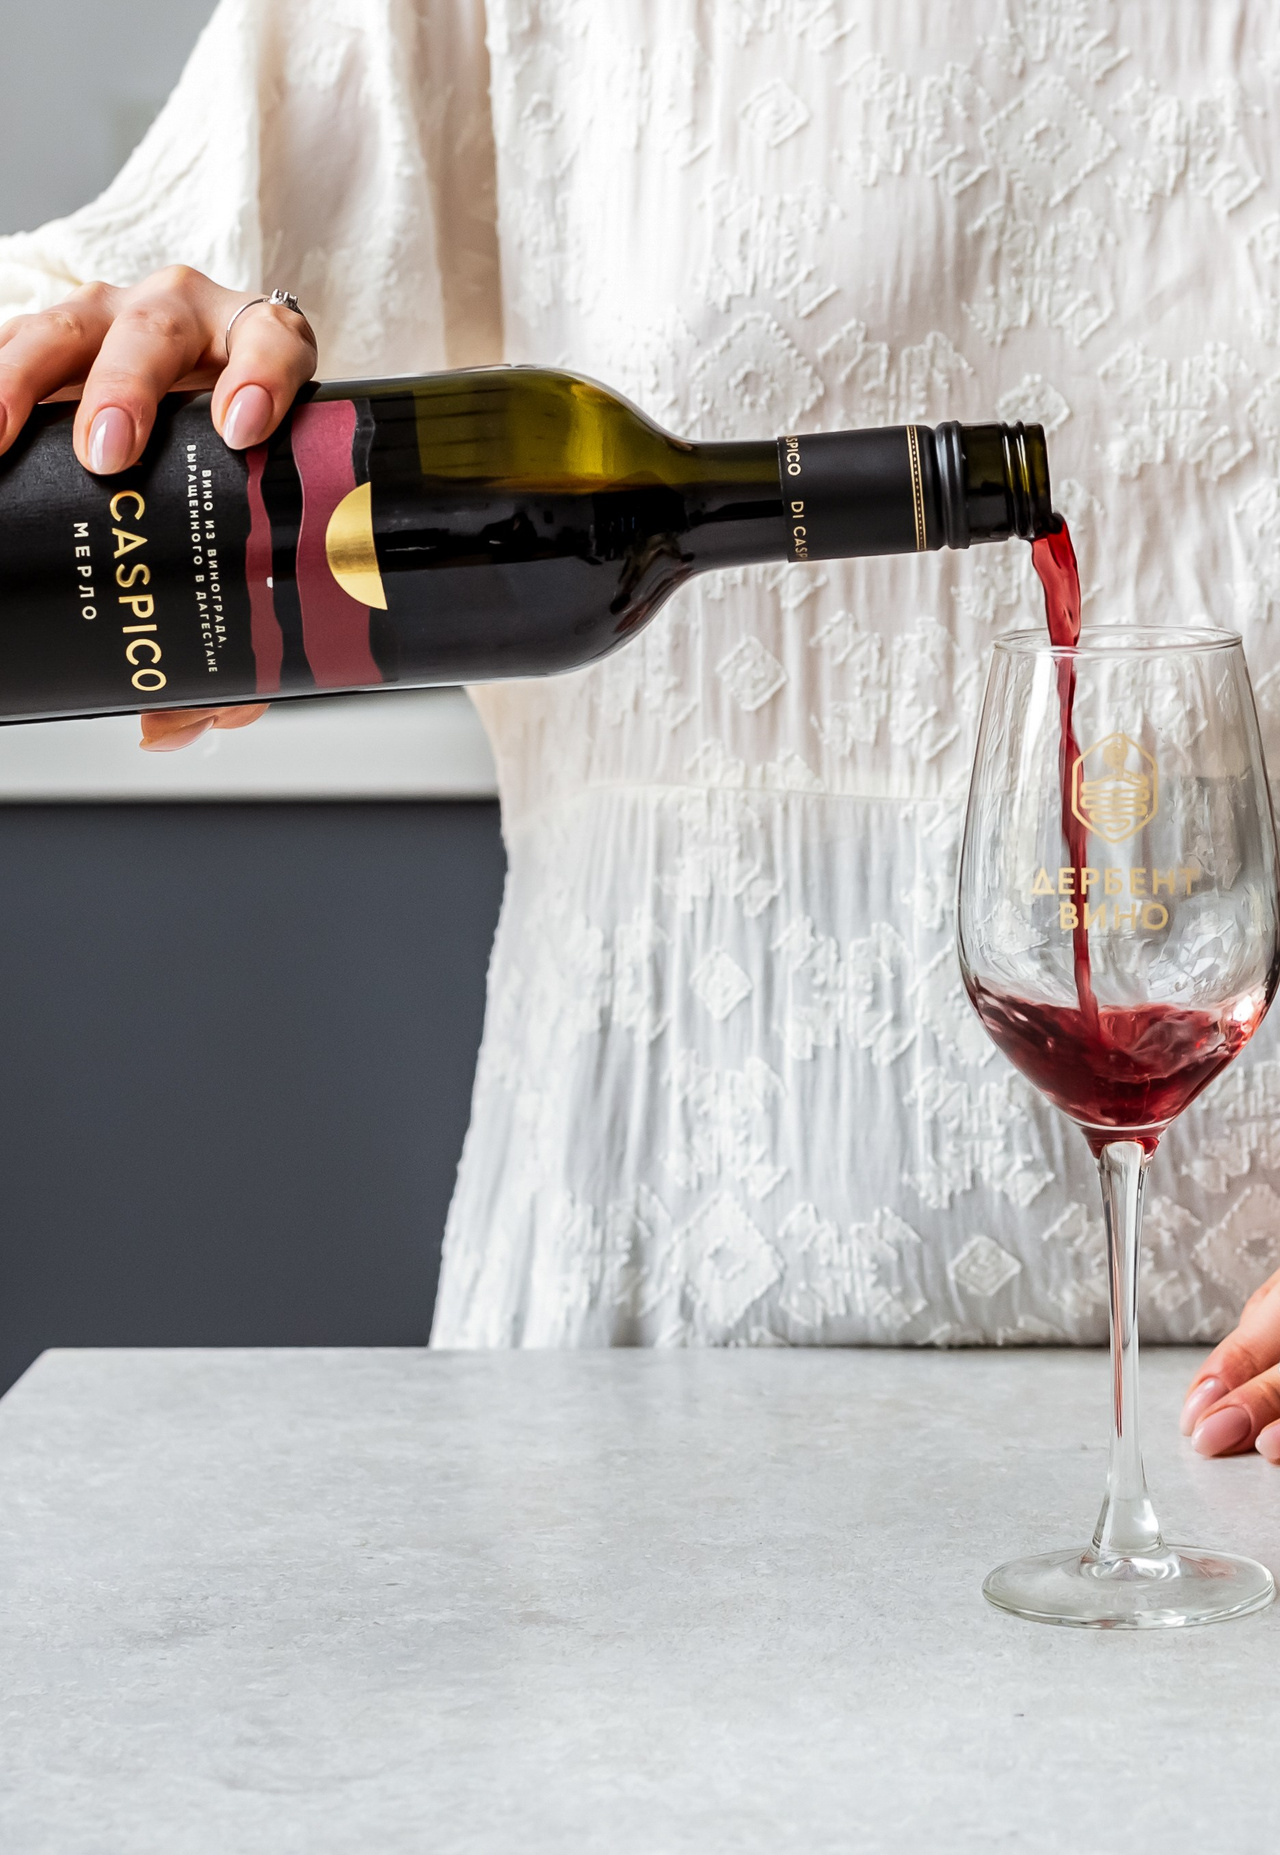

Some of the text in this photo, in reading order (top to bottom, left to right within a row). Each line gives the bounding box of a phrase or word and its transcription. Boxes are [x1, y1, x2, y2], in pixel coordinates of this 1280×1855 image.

[186, 444, 218, 673] ВЫРАЩЕННОГО В ДАГЕСТАНЕ
[201, 469, 227, 649] ВИНО ИЗ ВИНОГРАДА,
[790, 501, 805, 519] DI
[73, 521, 97, 621] МЕРЛО
[109, 489, 167, 692] CASPICO
[1031, 867, 1199, 896] ДЕРБЕНТ
[1059, 902, 1169, 931] ВИНО
